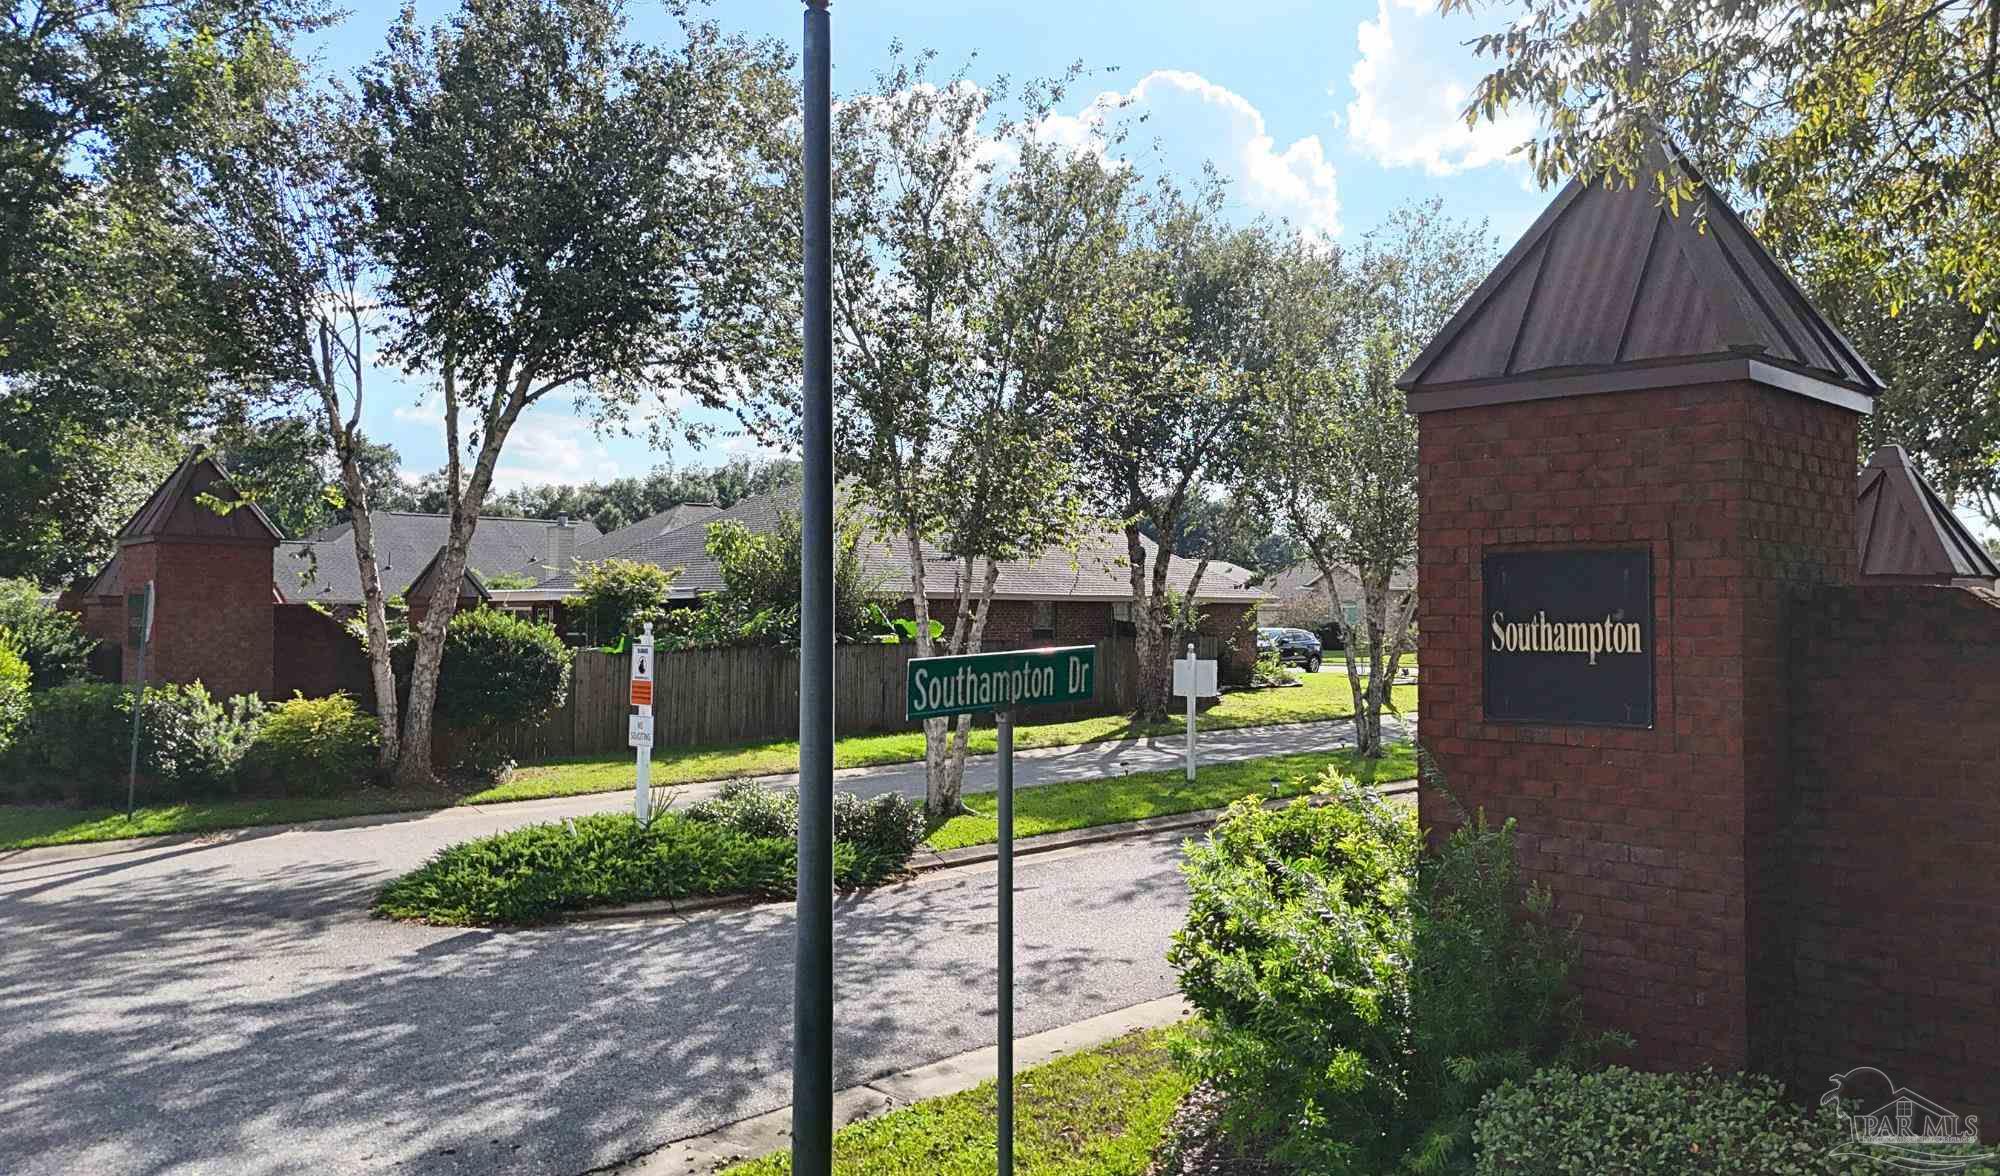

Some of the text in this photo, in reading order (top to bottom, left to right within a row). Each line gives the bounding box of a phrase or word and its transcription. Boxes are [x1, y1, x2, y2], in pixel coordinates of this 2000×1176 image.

[1491, 610, 1643, 665] Southampton
[914, 656, 1090, 711] Southampton Dr
